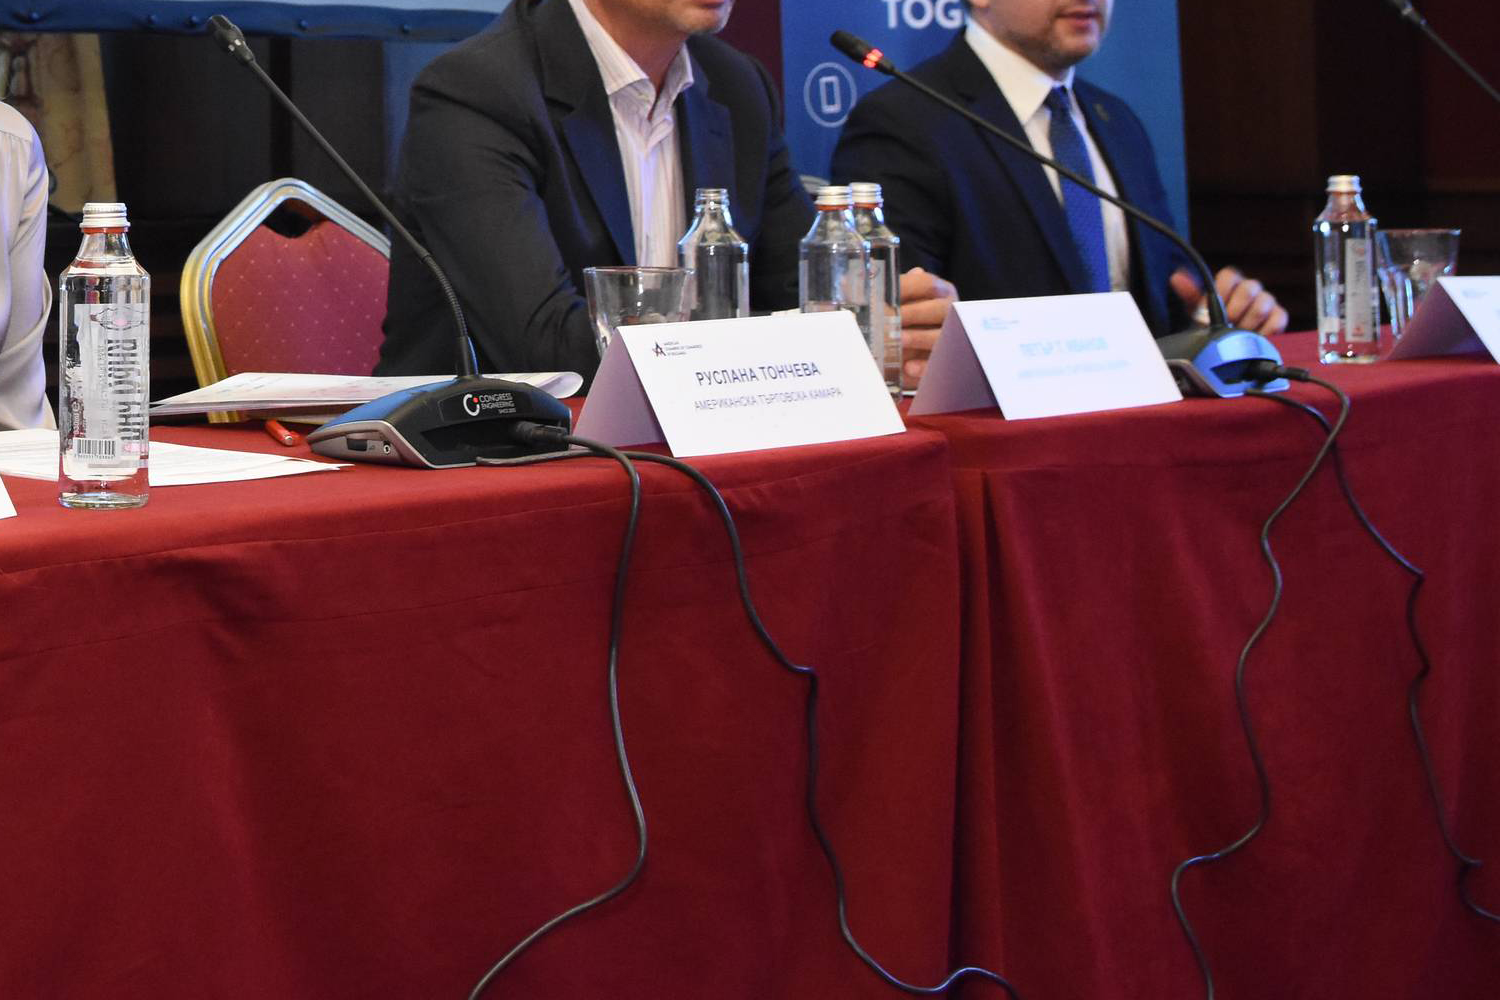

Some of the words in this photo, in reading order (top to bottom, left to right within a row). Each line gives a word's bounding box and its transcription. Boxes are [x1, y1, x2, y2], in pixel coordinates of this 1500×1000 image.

[695, 368, 760, 386] РУСЛАНА
[758, 361, 821, 381] ТОНЧЕВА
[479, 393, 513, 402] CONGRESS
